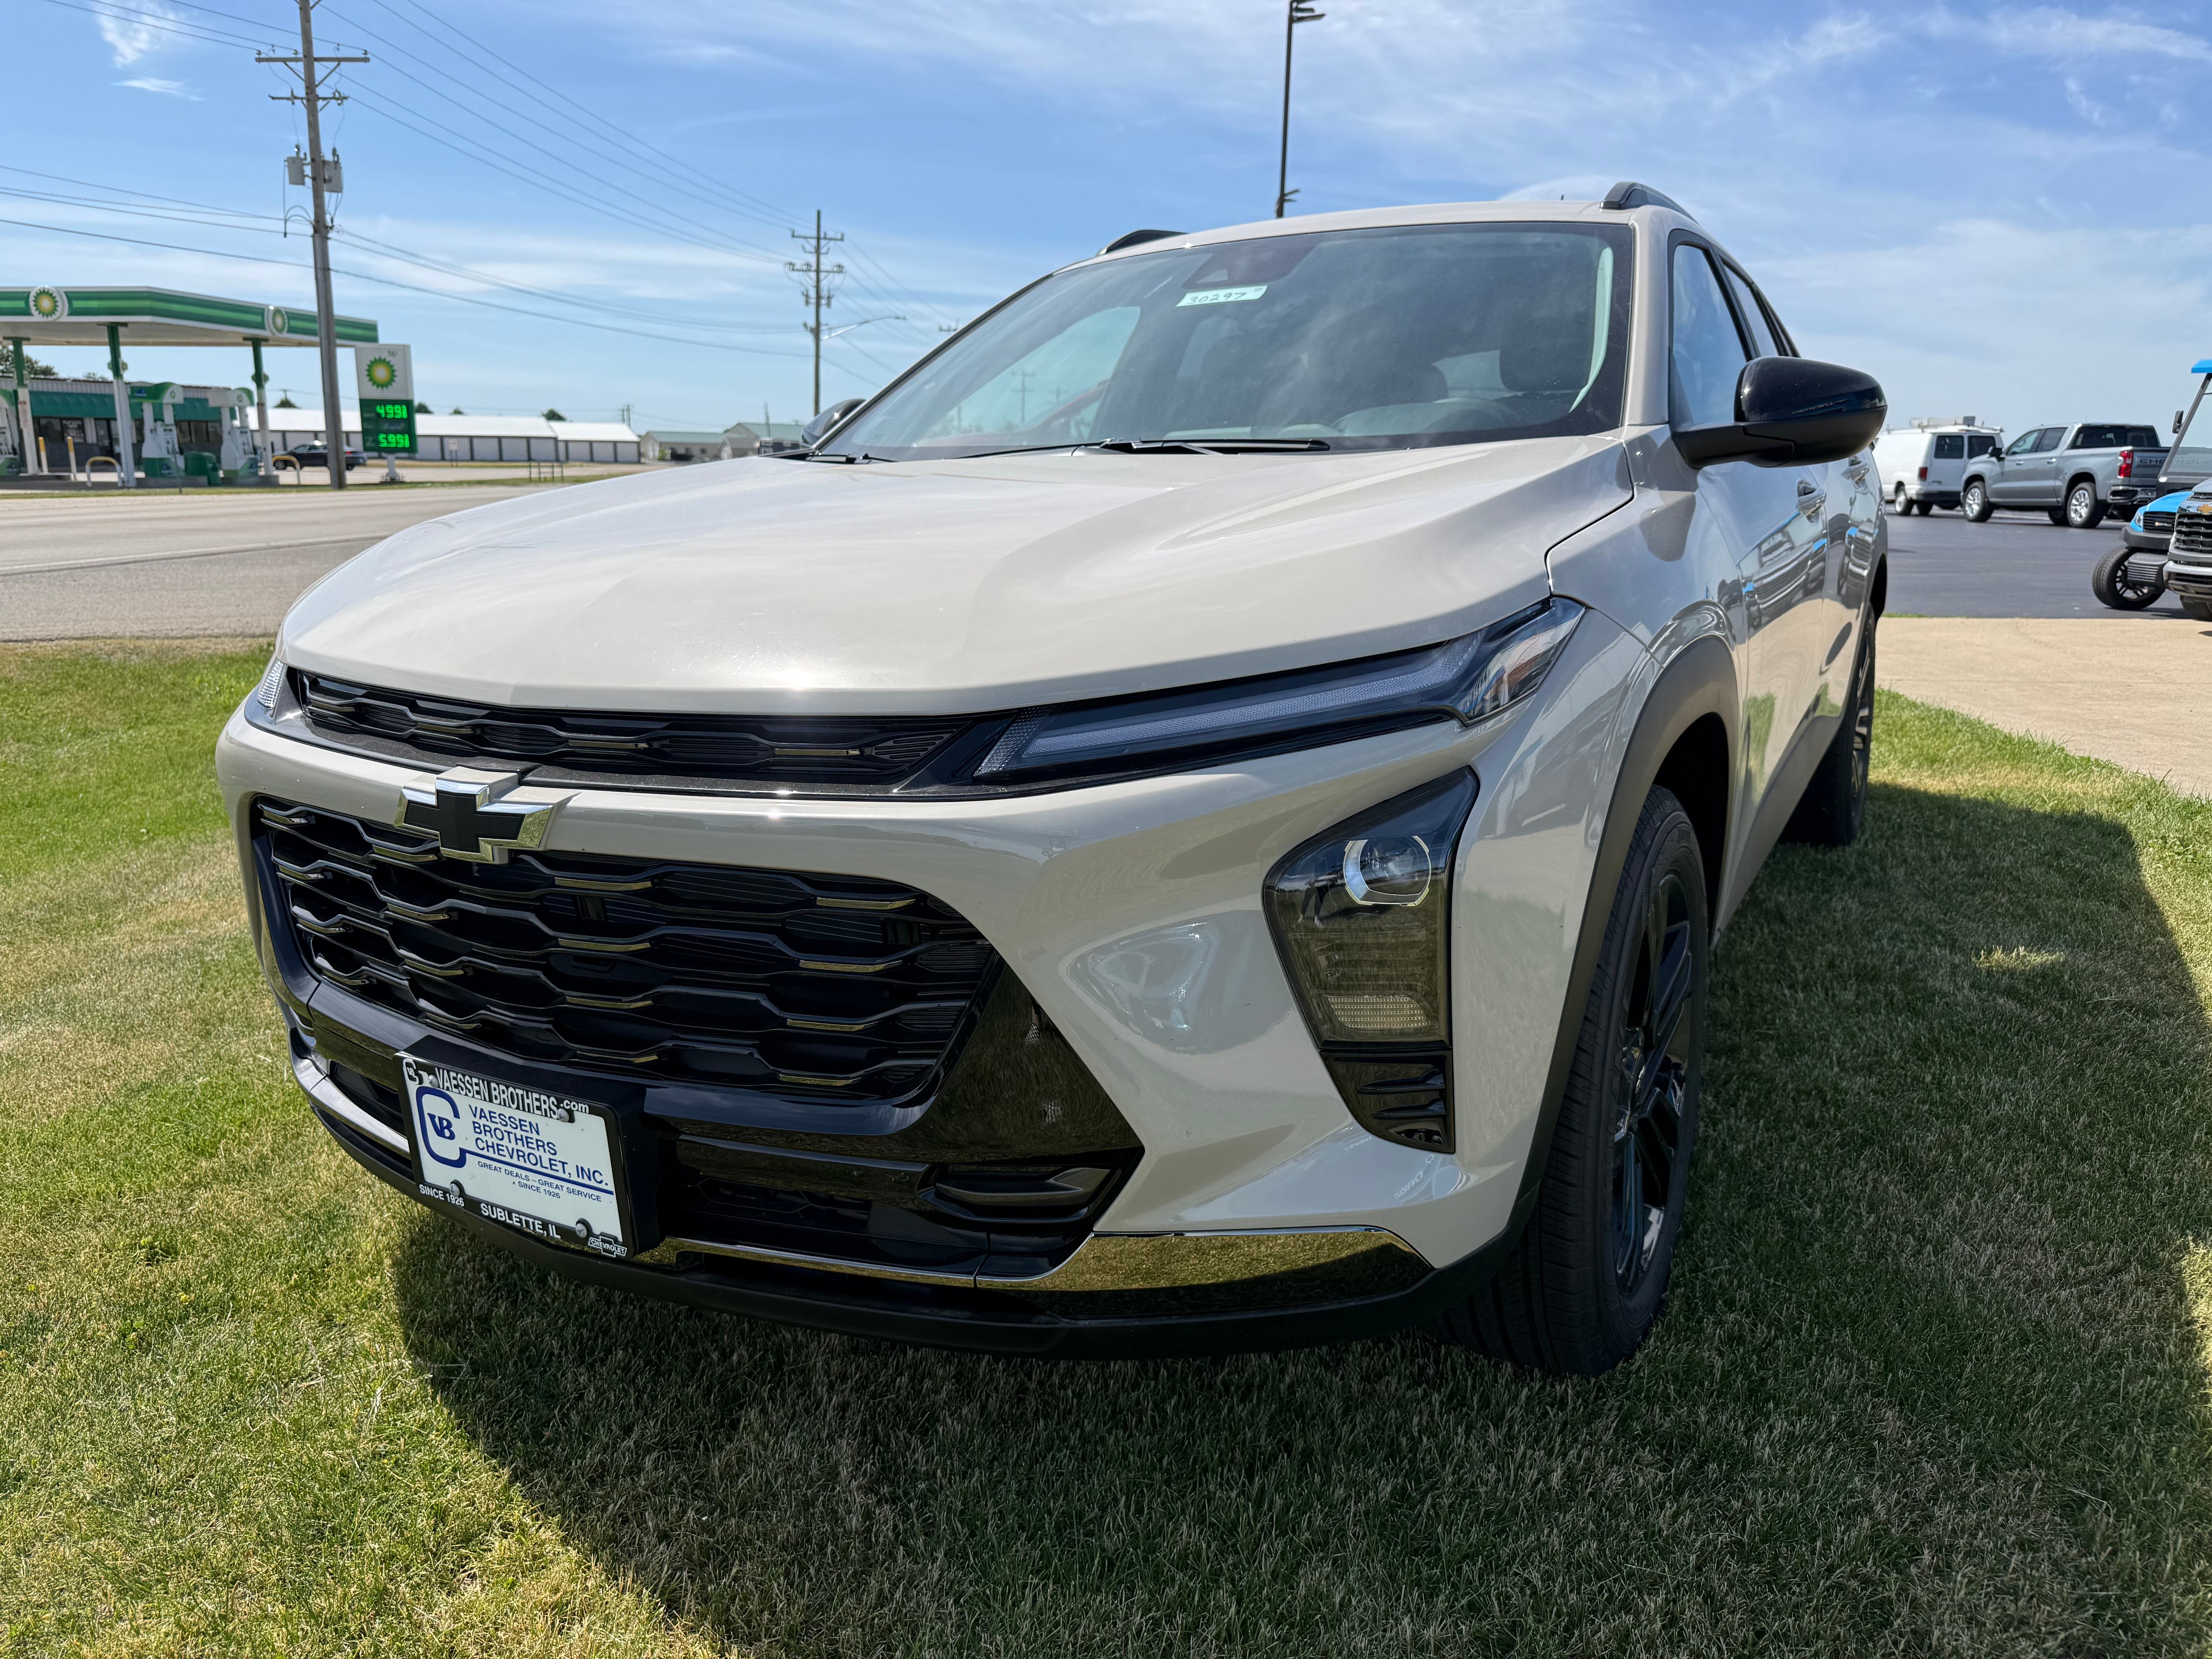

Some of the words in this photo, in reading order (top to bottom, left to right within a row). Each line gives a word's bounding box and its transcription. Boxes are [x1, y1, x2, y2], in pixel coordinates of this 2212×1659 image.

[1187, 293, 1247, 304] 30297
[435, 1068, 489, 1102] VAESSEN
[469, 1104, 540, 1136] VAESSEN
[472, 1120, 557, 1156] BROTHERS
[475, 1137, 572, 1178] CHEVROLET,
[575, 1164, 609, 1186] INC.
[419, 1184, 445, 1200] SINCE
[446, 1193, 464, 1207] 1926
[477, 1161, 502, 1173] GREAT
[505, 1169, 530, 1181] DEALS
[538, 1179, 565, 1192] GREAT
[567, 1187, 602, 1202] SERVICE
[518, 1180, 542, 1193] SINCE
[543, 1188, 561, 1199] 1926
[480, 1202, 547, 1237] SUBLETTE,
[548, 1224, 561, 1239] IL
[591, 1239, 625, 1254] CHEVROLET
